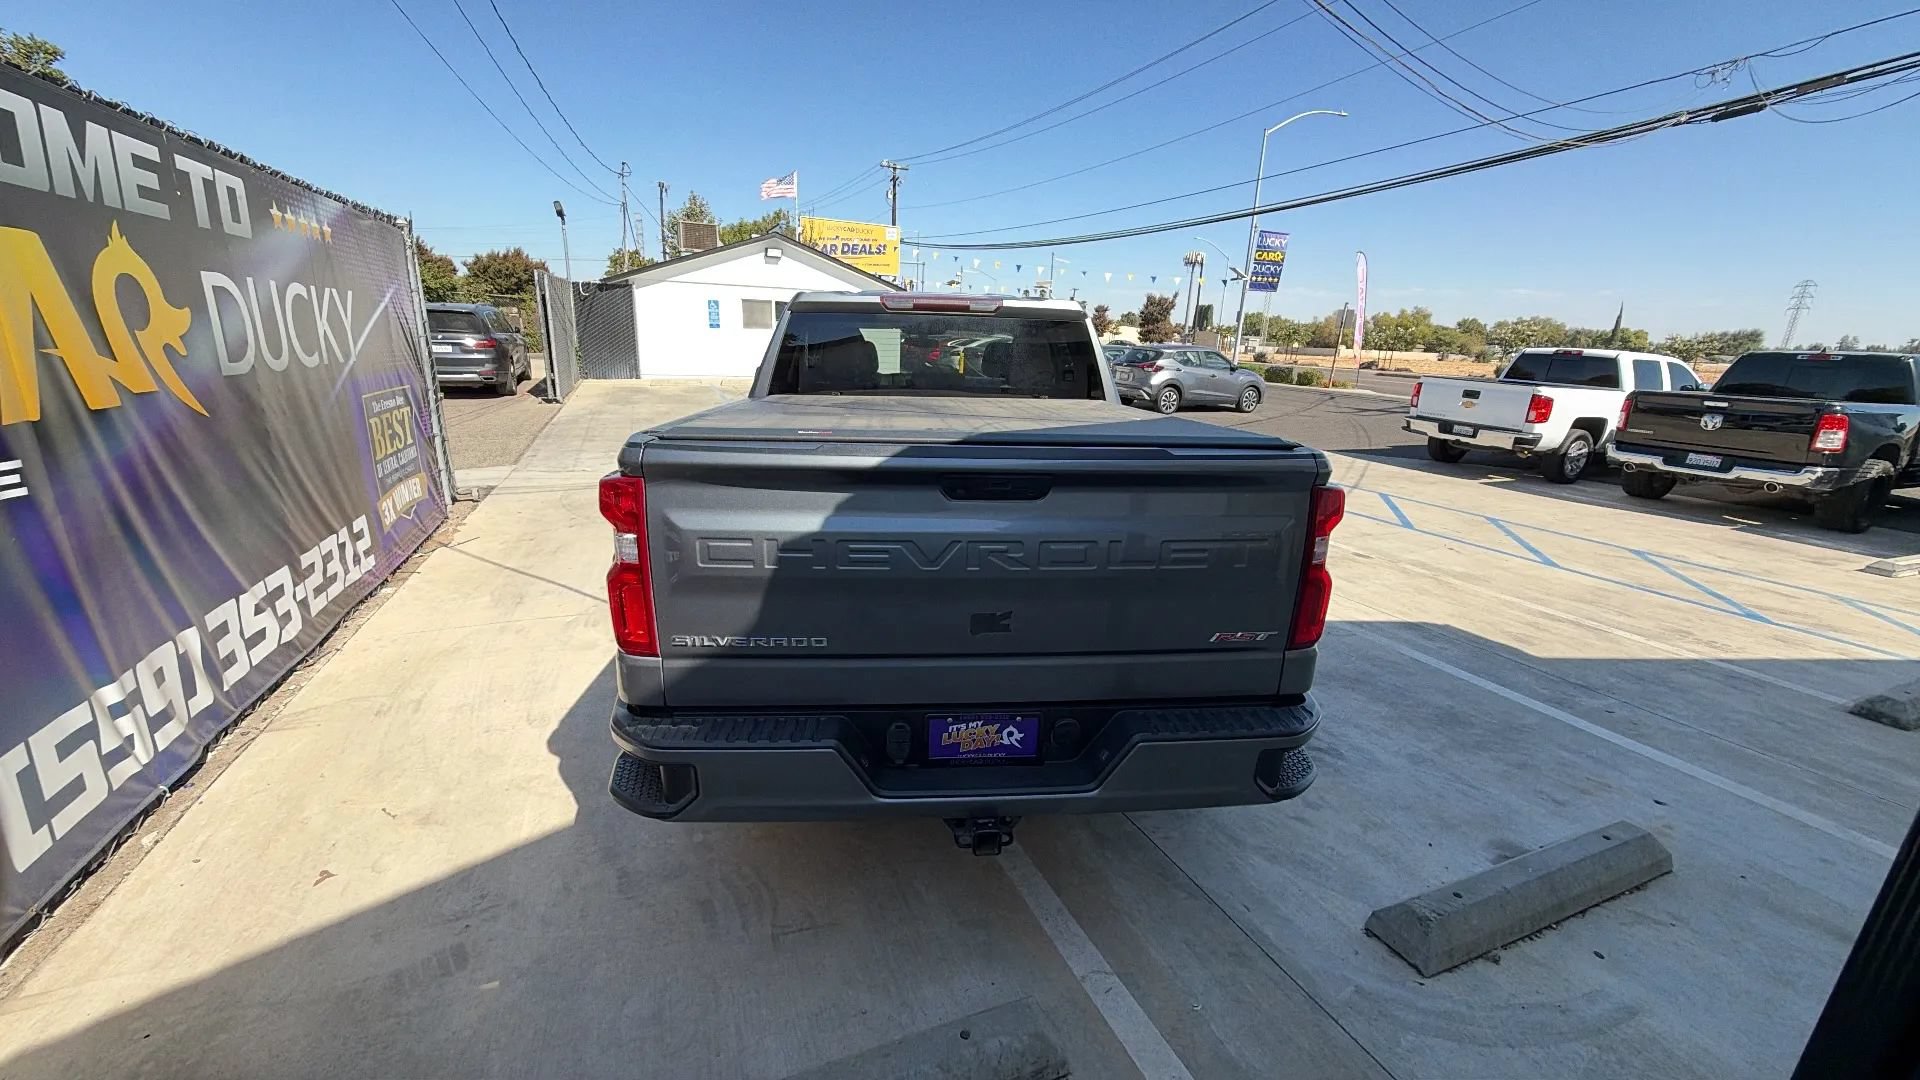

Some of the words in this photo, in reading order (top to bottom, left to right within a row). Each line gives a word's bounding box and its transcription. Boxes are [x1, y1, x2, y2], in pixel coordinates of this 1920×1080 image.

[173, 153, 253, 239] TO
[840, 242, 888, 256] DEALS!
[1258, 236, 1288, 247] LUCKY
[1253, 264, 1283, 274] DUCKY
[200, 270, 356, 377] DUCKY
[368, 406, 414, 461] BEST
[381, 497, 397, 526] 3X
[695, 537, 1270, 570] CHEVROLET
[671, 635, 829, 648] SILVERADO
[1209, 631, 1279, 642] RST
[0, 626, 215, 873] (559)
[205, 514, 376, 692] 353-2312
[941, 723, 1001, 746] LUCKY
[948, 723, 967, 733] IT'S
[968, 720, 984, 729] MY
